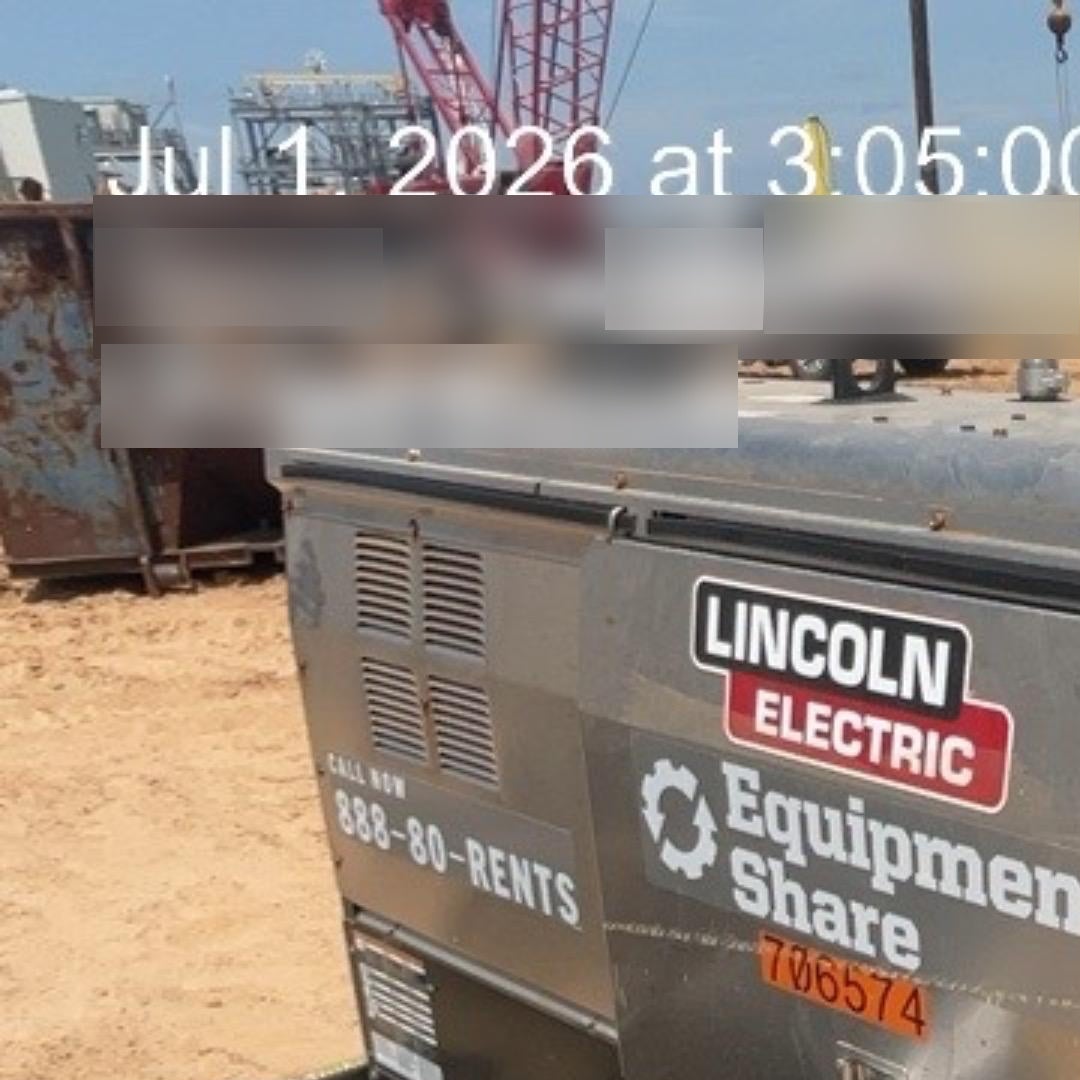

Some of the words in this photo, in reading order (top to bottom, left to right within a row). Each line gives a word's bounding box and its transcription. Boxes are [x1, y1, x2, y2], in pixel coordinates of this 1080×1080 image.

[706, 596, 950, 707] LINCOLN
[327, 753, 366, 785] CALL
[370, 768, 405, 799] NOW
[755, 689, 976, 787] ELECTRIC
[335, 788, 580, 926] 888-80-RENTS
[730, 847, 921, 971] Share
[764, 936, 926, 1036] 706574
